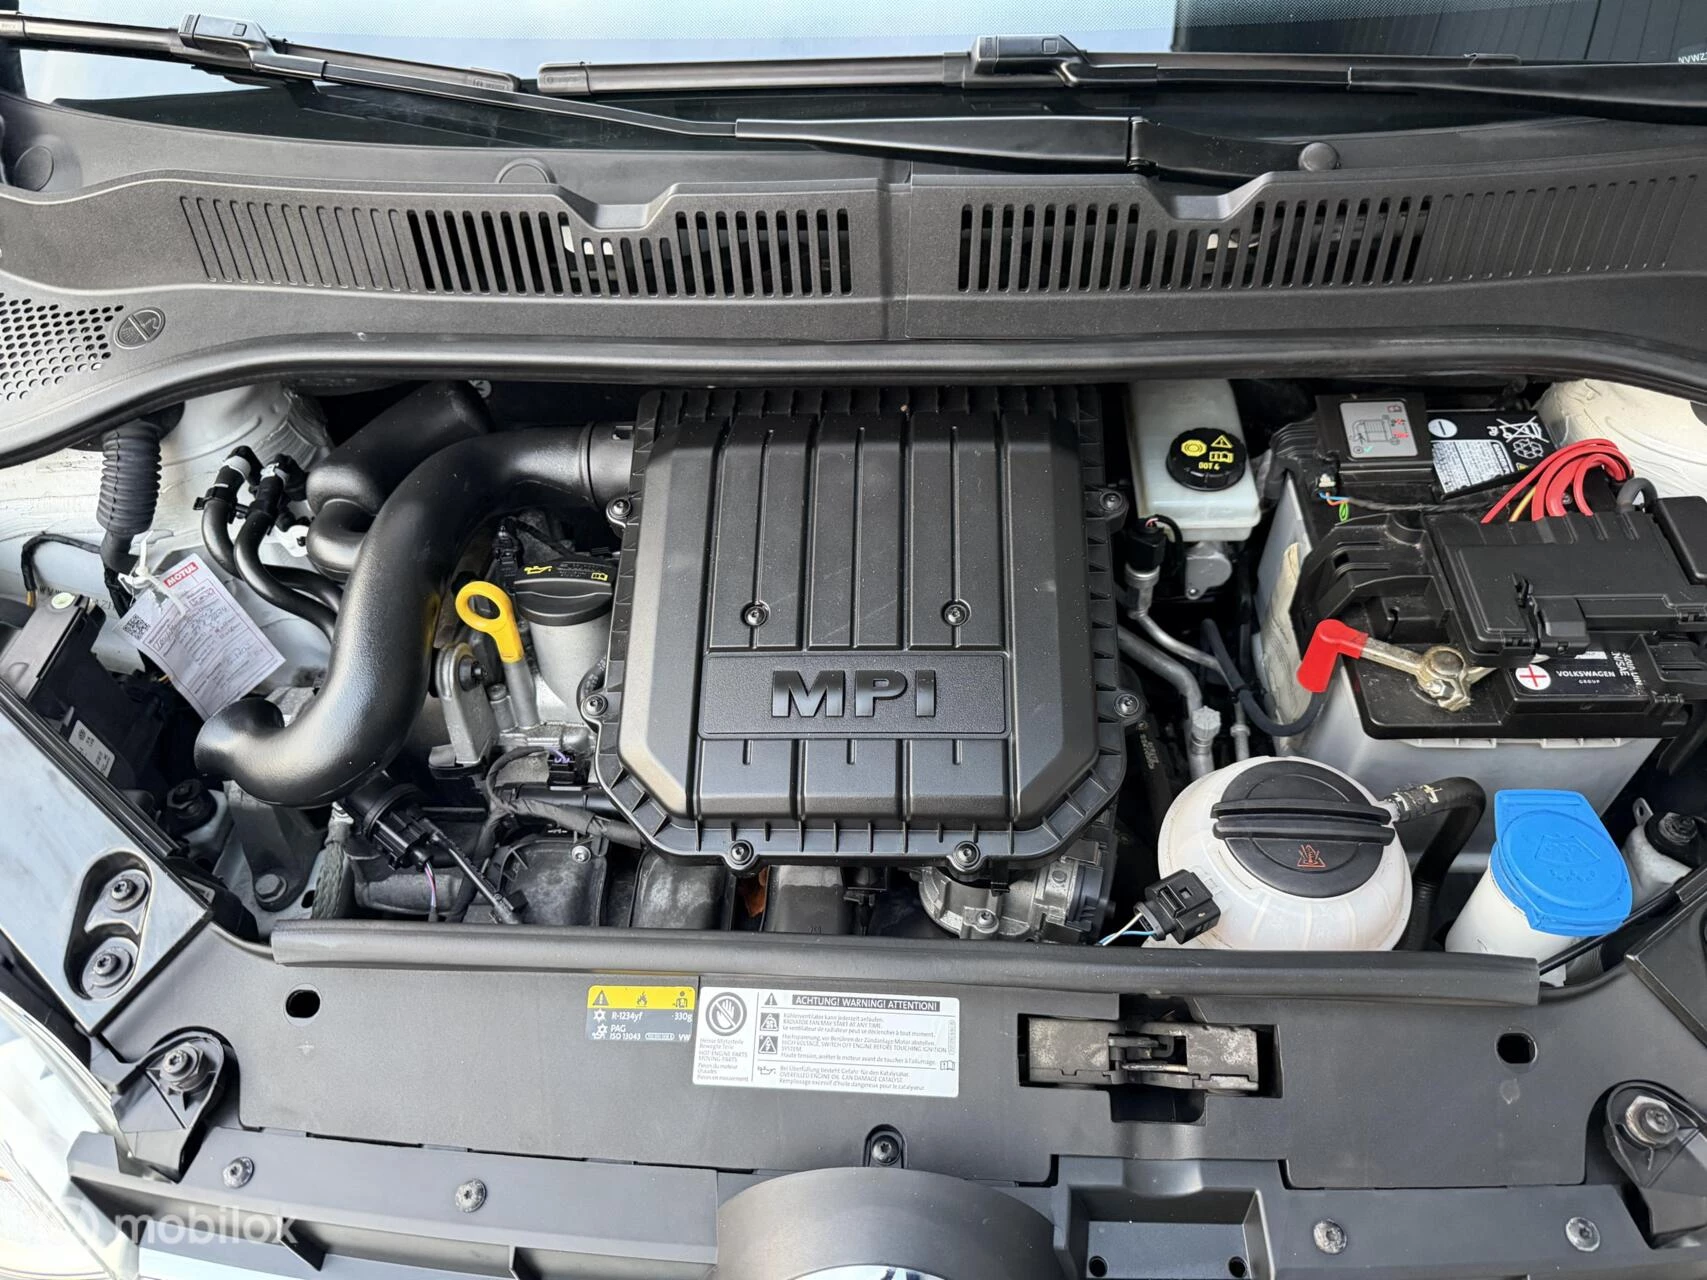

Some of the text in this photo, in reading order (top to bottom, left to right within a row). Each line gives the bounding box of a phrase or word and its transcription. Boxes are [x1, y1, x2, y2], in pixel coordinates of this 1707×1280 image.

[1199, 462, 1213, 470] DOT
[166, 562, 196, 586] MOTUL
[771, 669, 936, 718] MPI
[795, 996, 937, 1011] ACHTUNG! WARNING! ATTENTION!
[611, 1011, 642, 1022] R-1234yf
[610, 1024, 626, 1032] PAG
